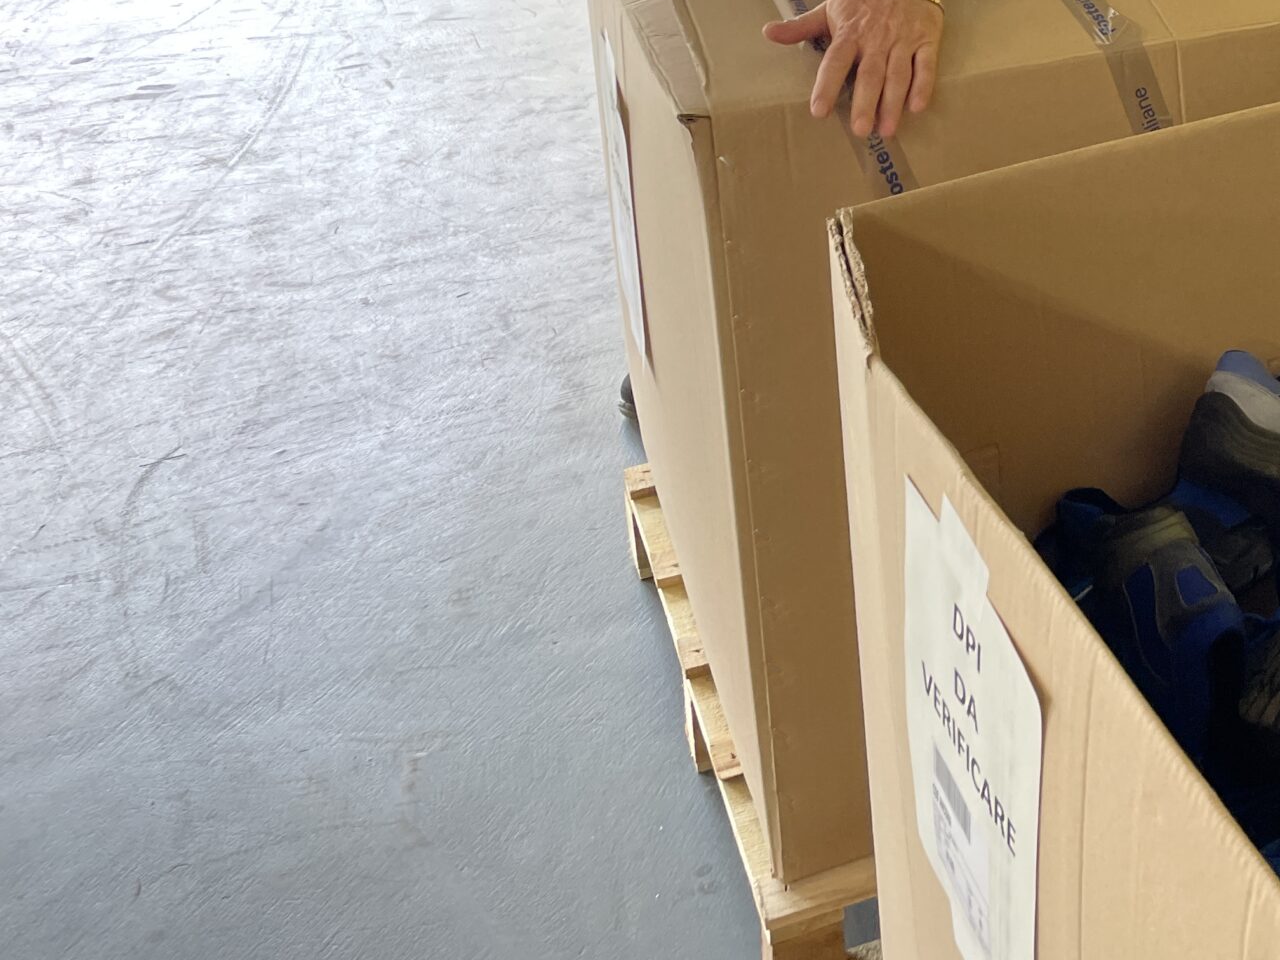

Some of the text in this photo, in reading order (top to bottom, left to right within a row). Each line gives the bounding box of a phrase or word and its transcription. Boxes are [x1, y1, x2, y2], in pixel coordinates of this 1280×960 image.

[953, 602, 982, 674] DPI
[953, 667, 979, 734] DA
[921, 659, 1016, 857] VERIFICARE
